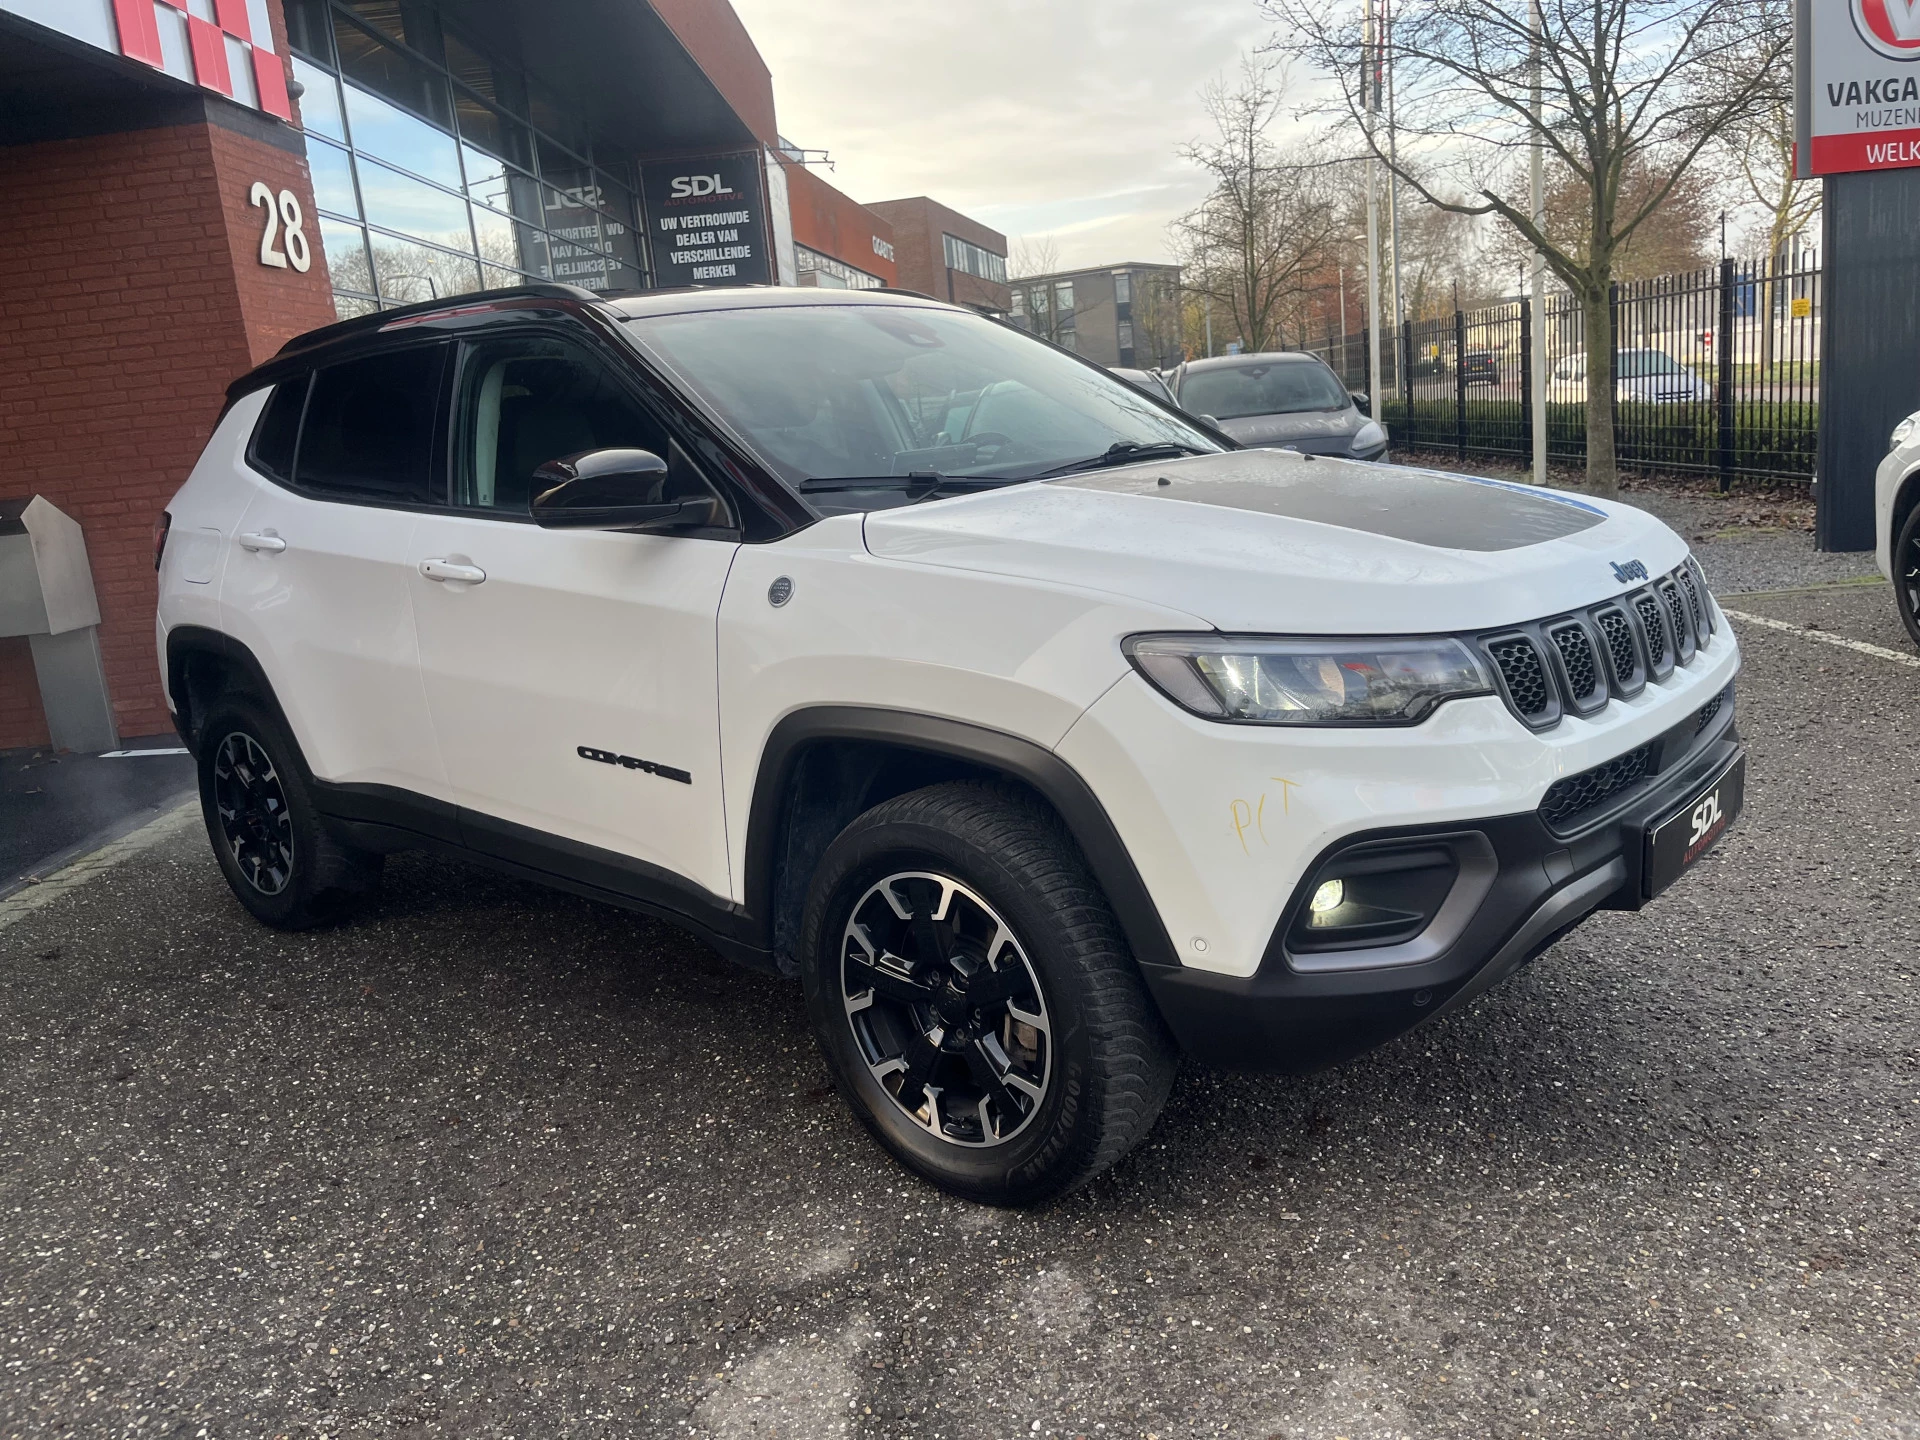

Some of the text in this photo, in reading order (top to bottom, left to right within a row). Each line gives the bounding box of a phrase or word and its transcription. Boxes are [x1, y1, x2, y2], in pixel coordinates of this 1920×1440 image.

[1827, 76, 1919, 107] VAKGA
[1856, 108, 1920, 128] MUZEN
[1866, 140, 1920, 163] WELK
[671, 174, 733, 198] SDL
[664, 192, 745, 207] AUTOMOTIVE
[251, 181, 311, 273] 28
[660, 211, 750, 231] UW VERTROUWDE
[676, 229, 738, 247] DEALER VAN
[670, 245, 751, 264] VERSCHILLENDE
[693, 264, 736, 280] MERKEN
[1609, 559, 1649, 583] Jeep
[1689, 789, 1722, 847] SDL
